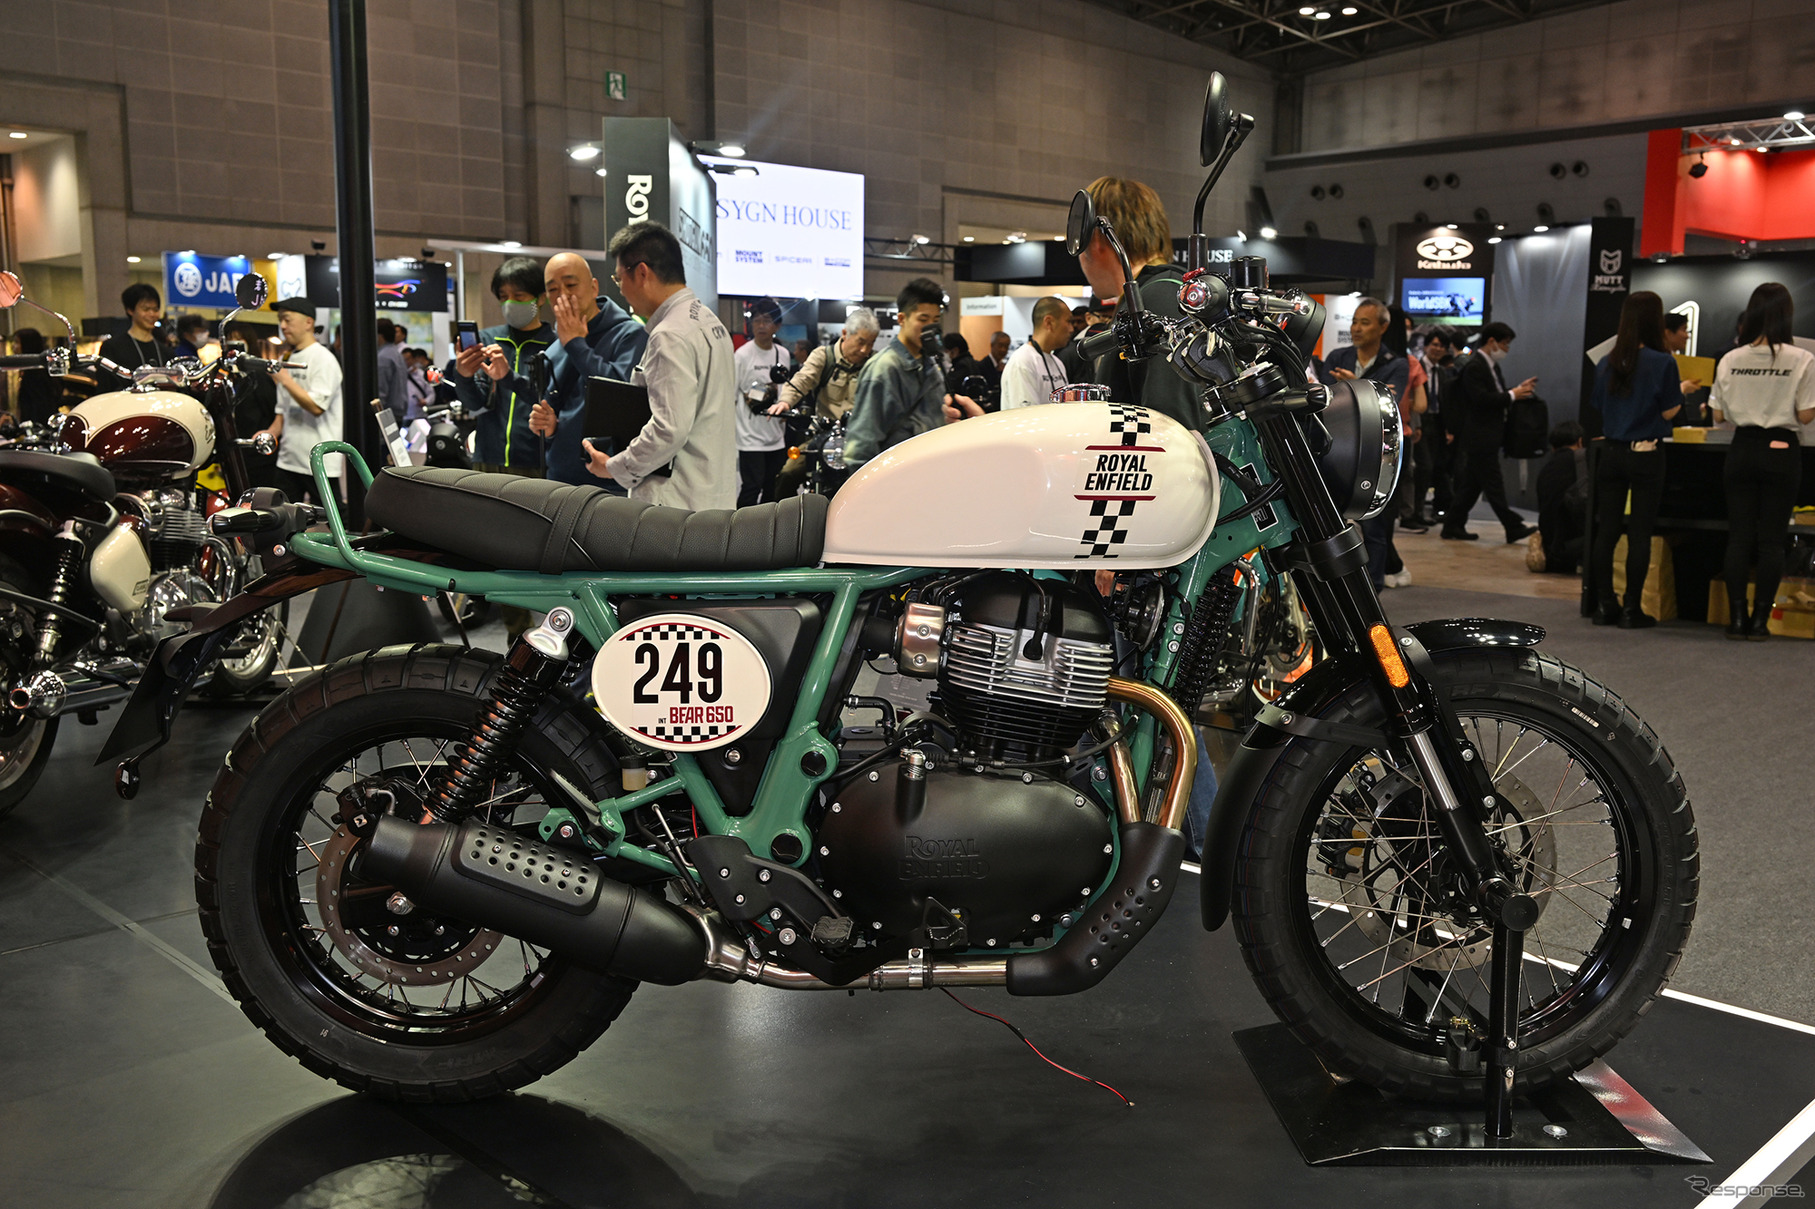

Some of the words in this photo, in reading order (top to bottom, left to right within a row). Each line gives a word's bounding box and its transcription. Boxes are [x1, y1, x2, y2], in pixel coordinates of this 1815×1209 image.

[716, 198, 777, 223] SYGN
[783, 204, 852, 231] HOUSE
[1594, 275, 1623, 285] MUTT
[1730, 367, 1793, 377] THROTTLE
[1096, 453, 1148, 473] ROYAL
[1084, 472, 1154, 491] ENFIELD
[633, 641, 723, 705] 249
[657, 717, 667, 725] INT
[669, 706, 704, 724] BEAR
[705, 705, 734, 724] 650
[905, 835, 980, 861] ROYAL
[899, 858, 990, 881] ENFIELD
